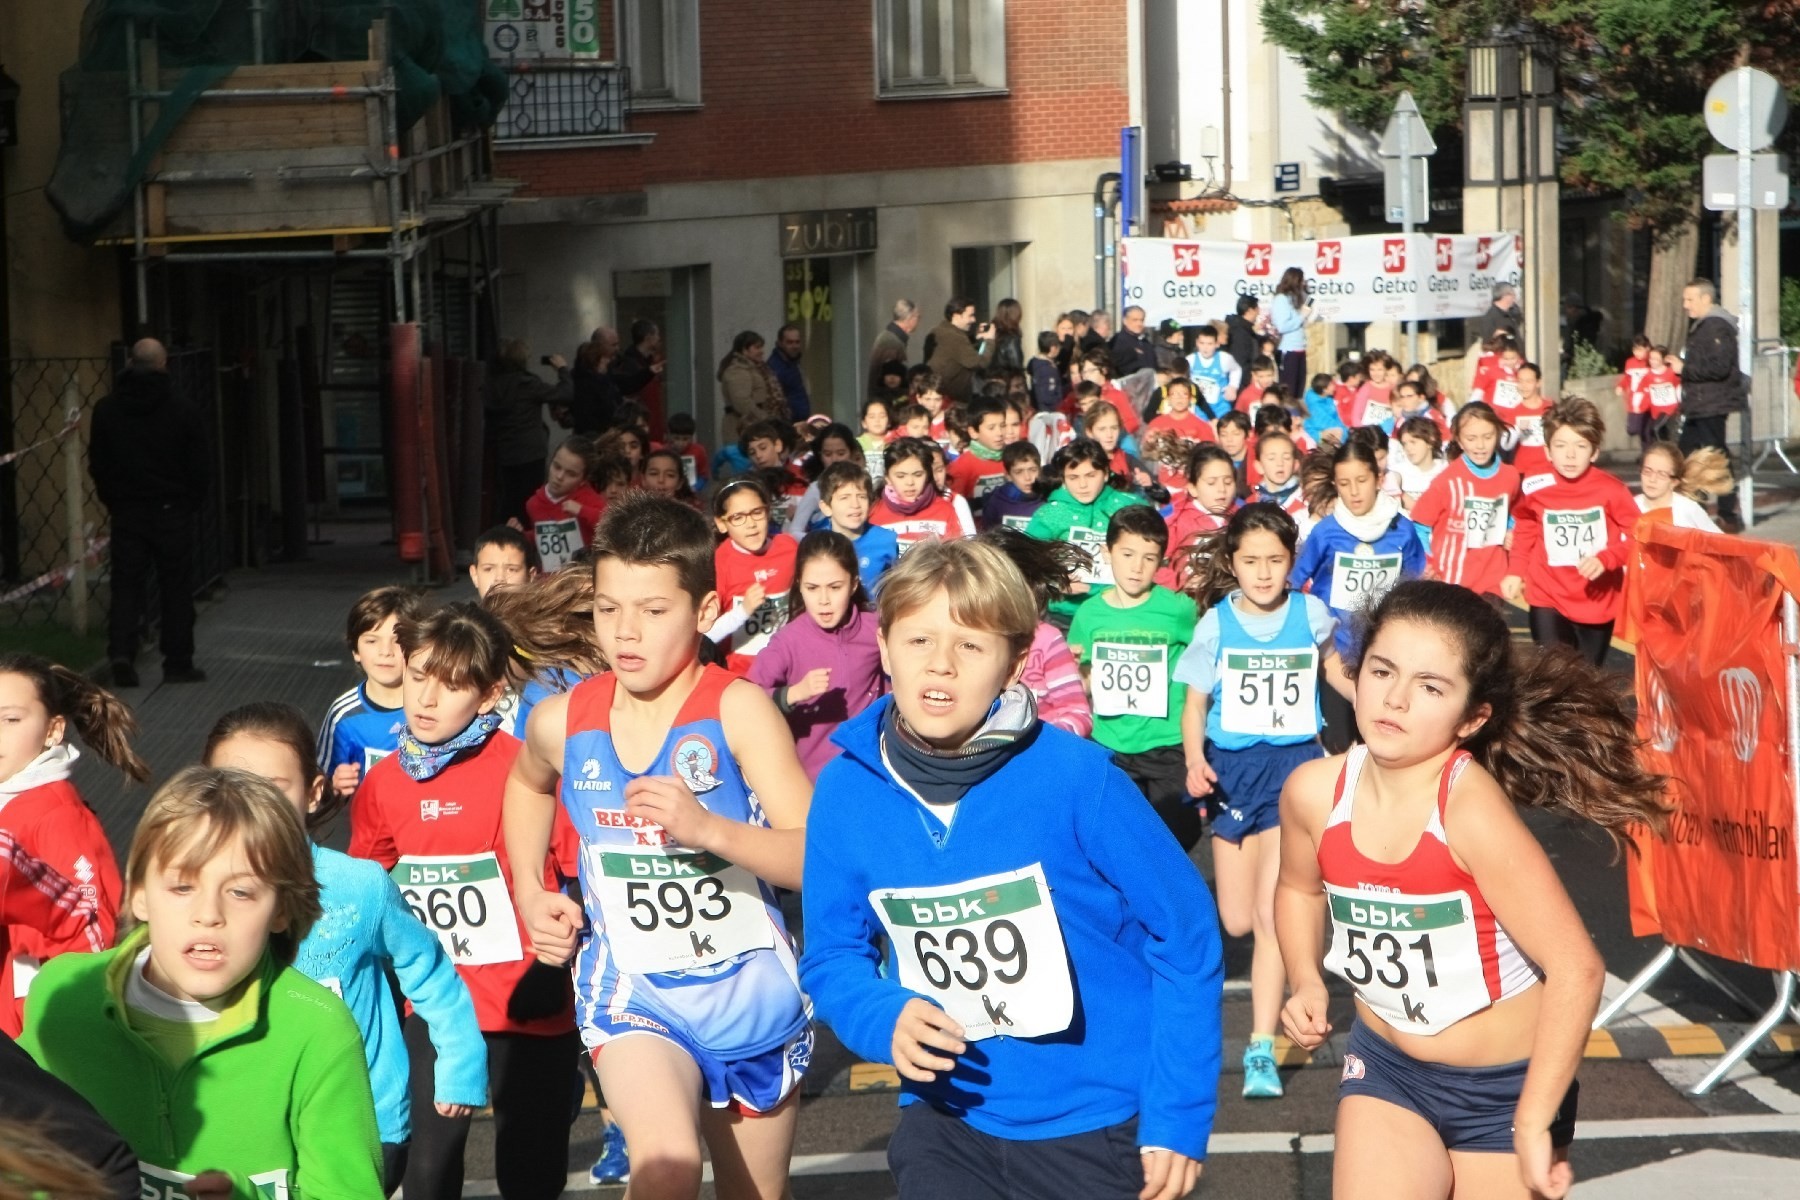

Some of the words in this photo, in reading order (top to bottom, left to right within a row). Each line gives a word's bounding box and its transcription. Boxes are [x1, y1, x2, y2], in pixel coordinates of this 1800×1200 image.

[1163, 280, 1216, 298] Getxo
[1372, 276, 1418, 294] Getxo
[1428, 274, 1459, 292] Getxo
[540, 533, 571, 556] 581
[1554, 525, 1596, 548] 374
[1352, 560, 1380, 569] bbk
[1345, 569, 1388, 593] 502
[1107, 649, 1140, 662] bbk
[1247, 656, 1288, 669] bbk
[1101, 662, 1151, 692] 369
[1239, 672, 1300, 707] 515
[573, 779, 612, 791] VIATOR
[409, 865, 460, 884] bbk
[629, 857, 696, 876] bbk
[401, 884, 487, 931] 660
[627, 876, 732, 932] 593
[911, 897, 986, 925] bbk
[1350, 901, 1413, 928] bbk
[689, 930, 717, 958] k
[914, 918, 1029, 991] 639
[1343, 928, 1439, 990] 531
[981, 994, 1014, 1027] k
[1401, 992, 1430, 1026] k
